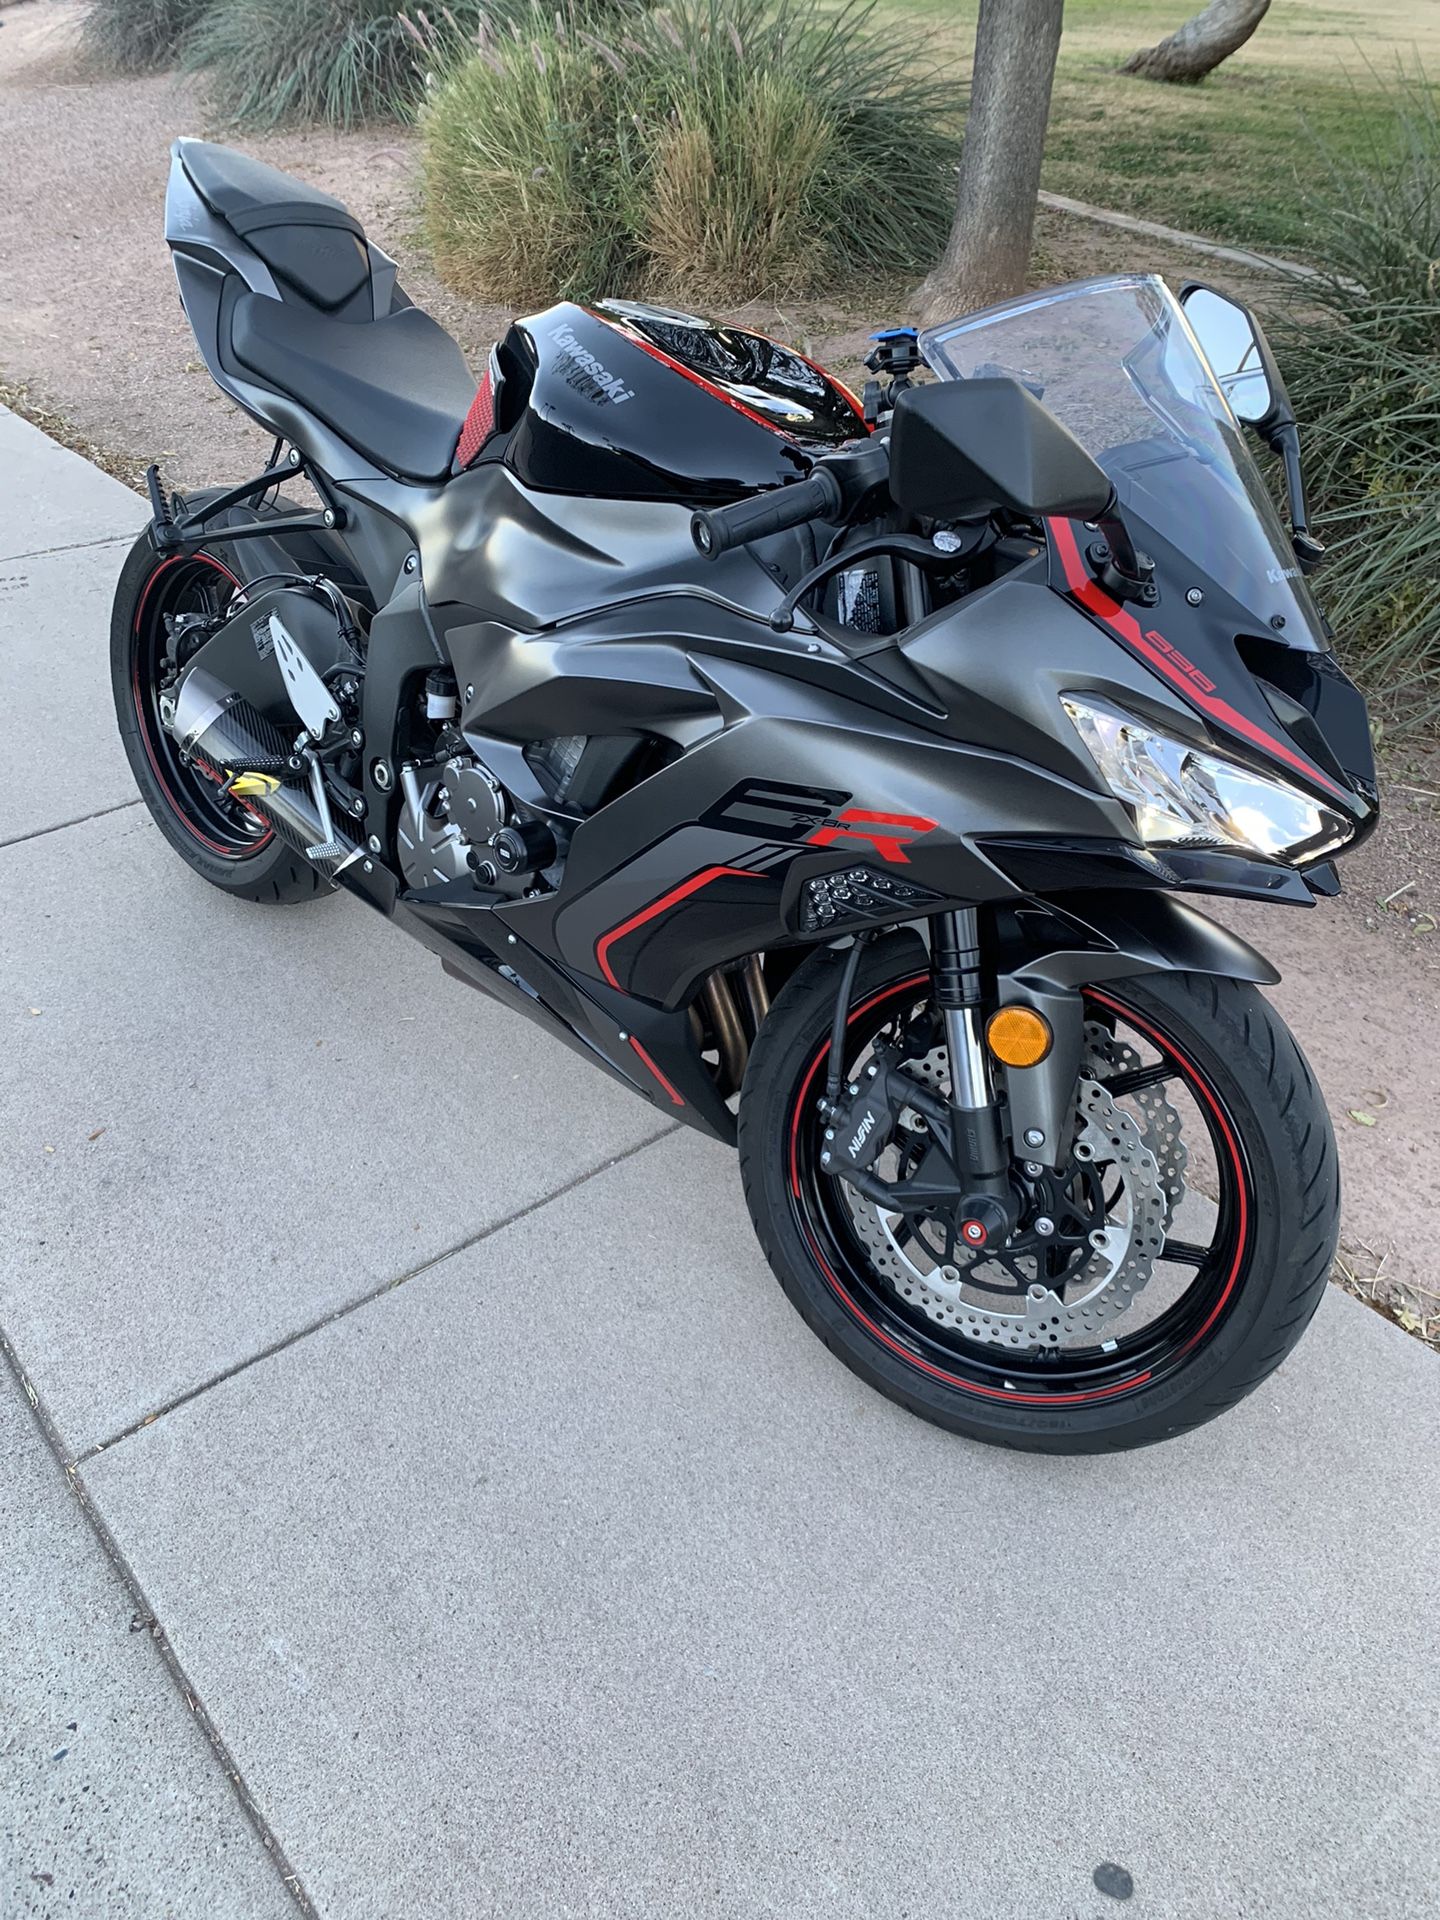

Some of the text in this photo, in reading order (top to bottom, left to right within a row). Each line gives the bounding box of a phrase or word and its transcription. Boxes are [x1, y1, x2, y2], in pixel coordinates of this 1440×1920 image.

[549, 324, 635, 404] Kawasaki
[1267, 566, 1301, 584] Kawa
[1145, 630, 1216, 693] 636
[848, 1110, 876, 1159] NISSIN
